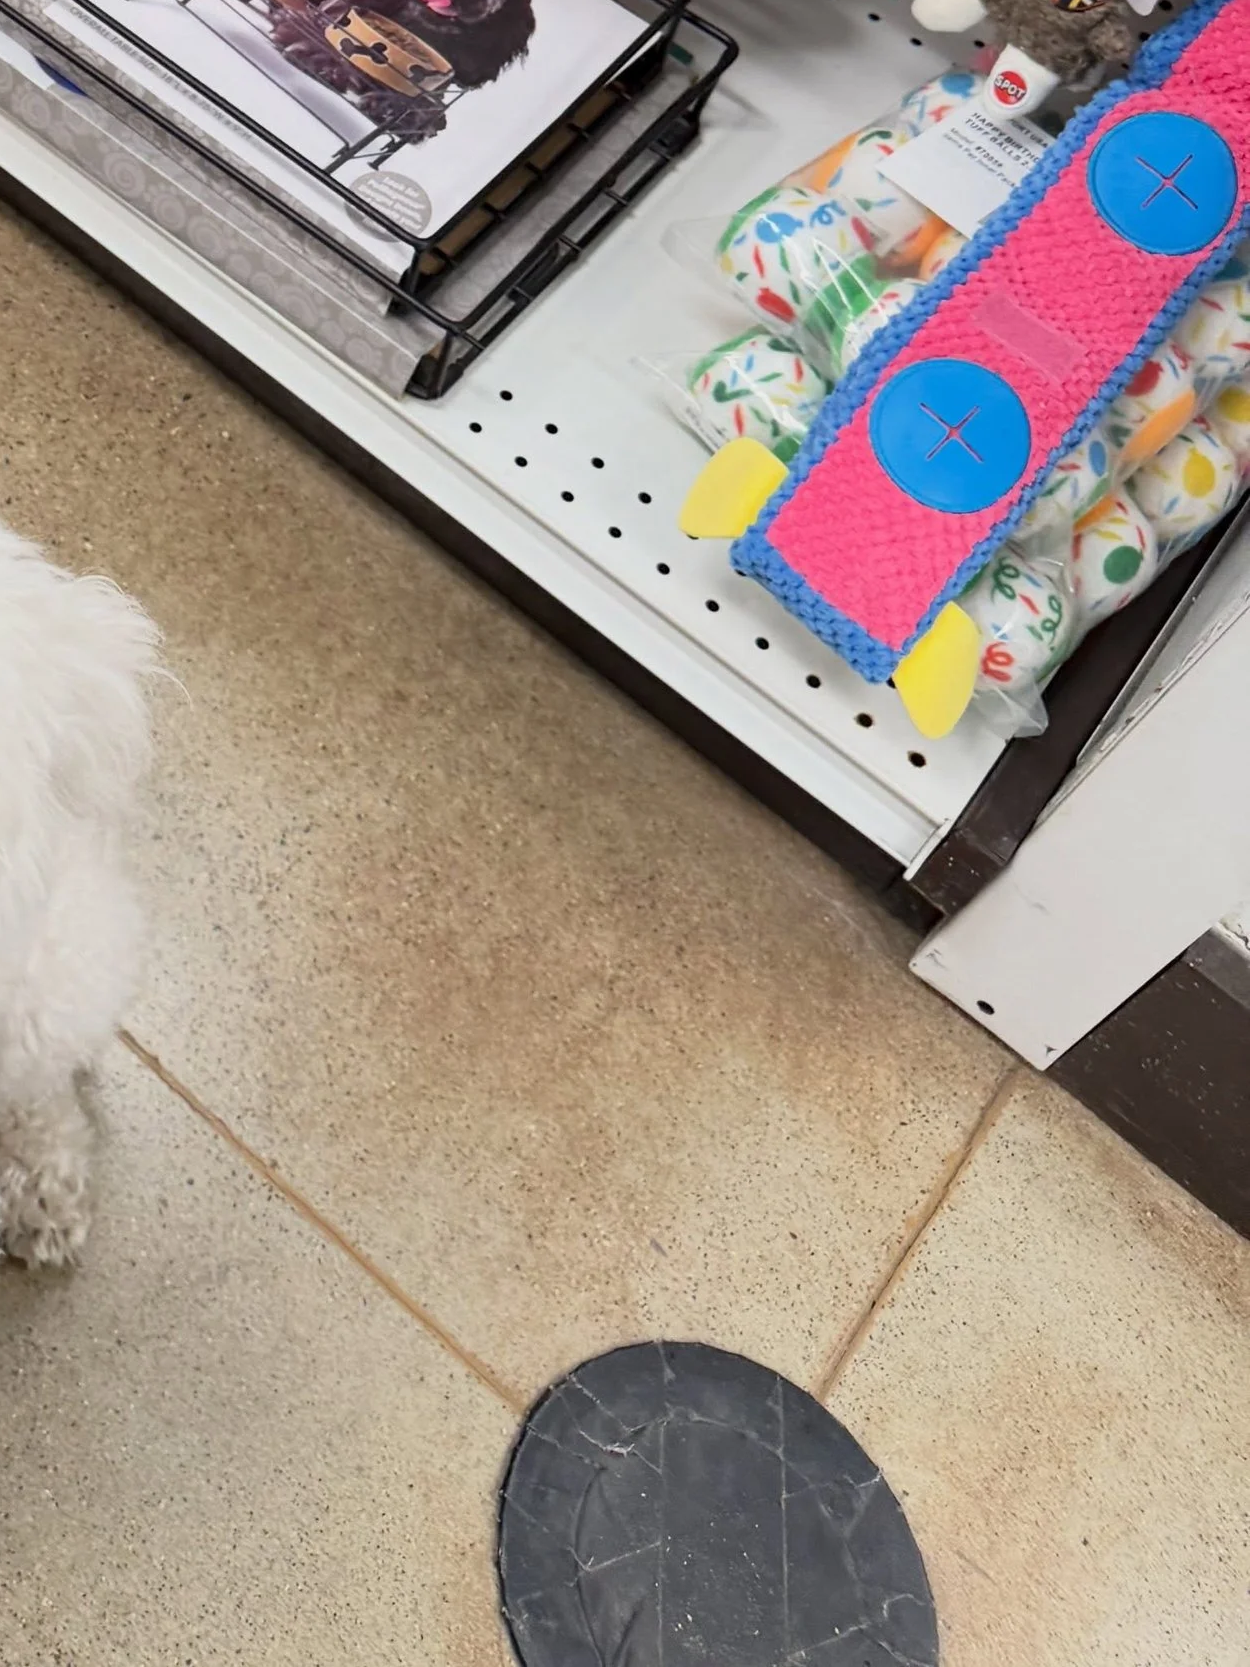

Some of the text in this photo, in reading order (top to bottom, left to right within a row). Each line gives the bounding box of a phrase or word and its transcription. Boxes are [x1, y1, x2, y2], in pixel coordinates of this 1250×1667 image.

[994, 75, 1027, 103] SPOT
[965, 118, 989, 138] TUFF
[989, 135, 1021, 162] BALLS
[971, 112, 1002, 140] HAPPY
[1031, 134, 1049, 148] USA
